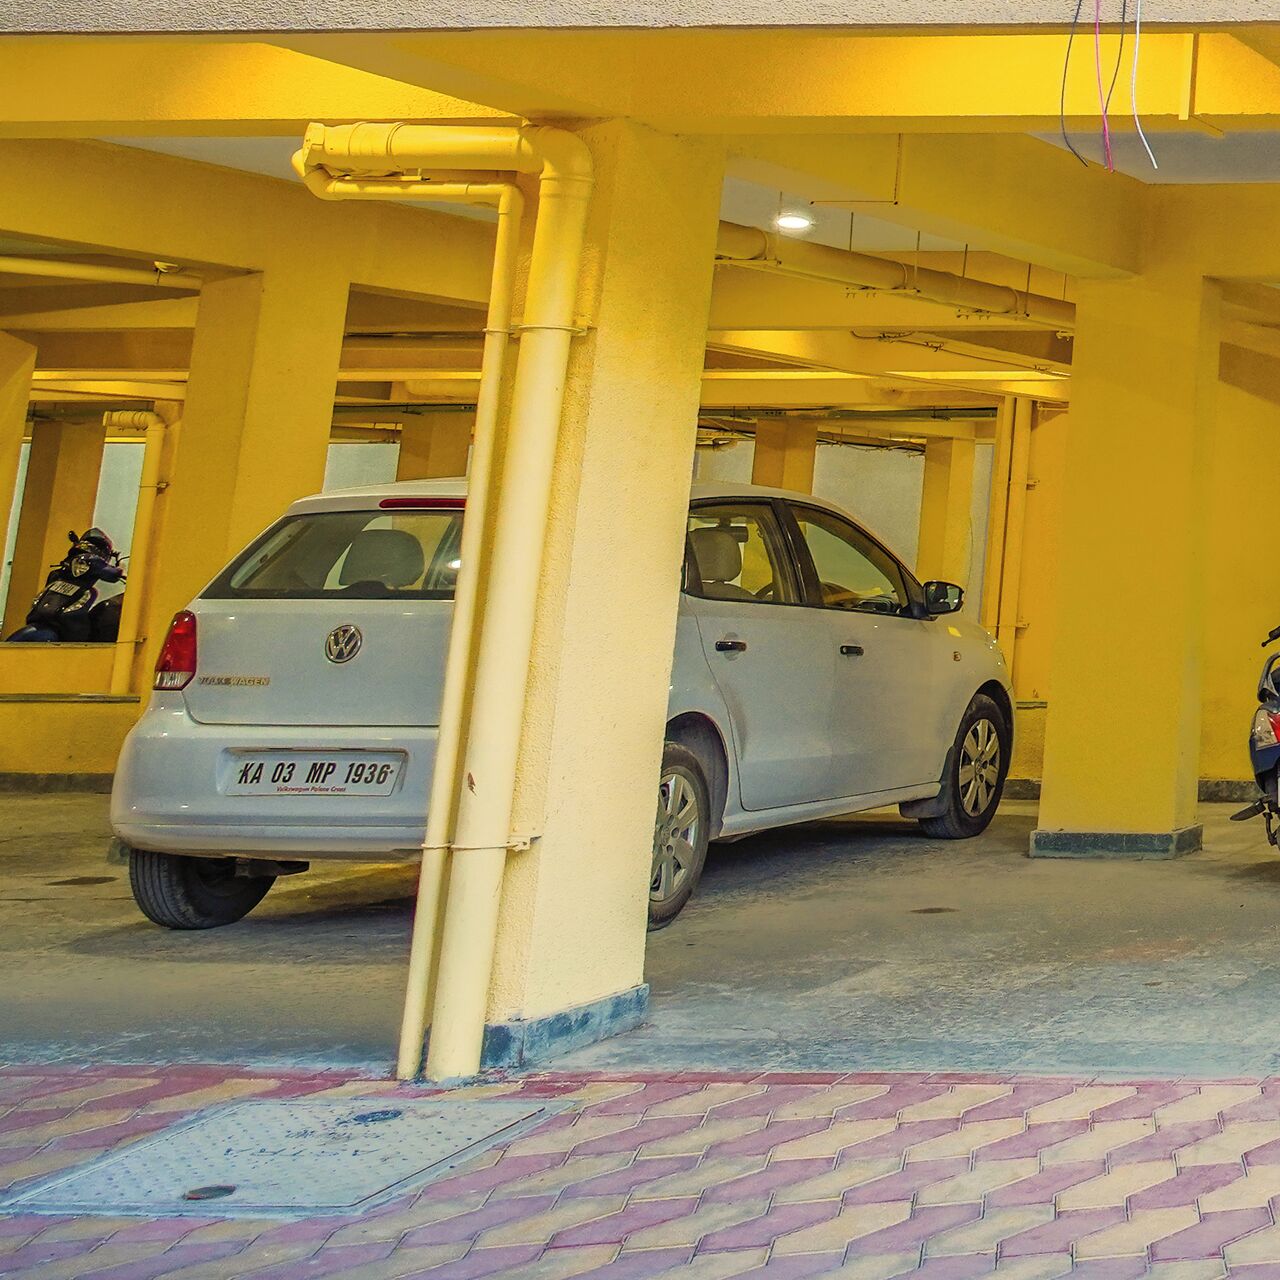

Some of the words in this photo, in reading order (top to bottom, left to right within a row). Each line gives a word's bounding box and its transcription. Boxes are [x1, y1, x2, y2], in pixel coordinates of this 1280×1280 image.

[237, 762, 264, 784] KA
[271, 762, 296, 784] 03
[305, 762, 337, 784] MP
[344, 762, 392, 785] 1936
